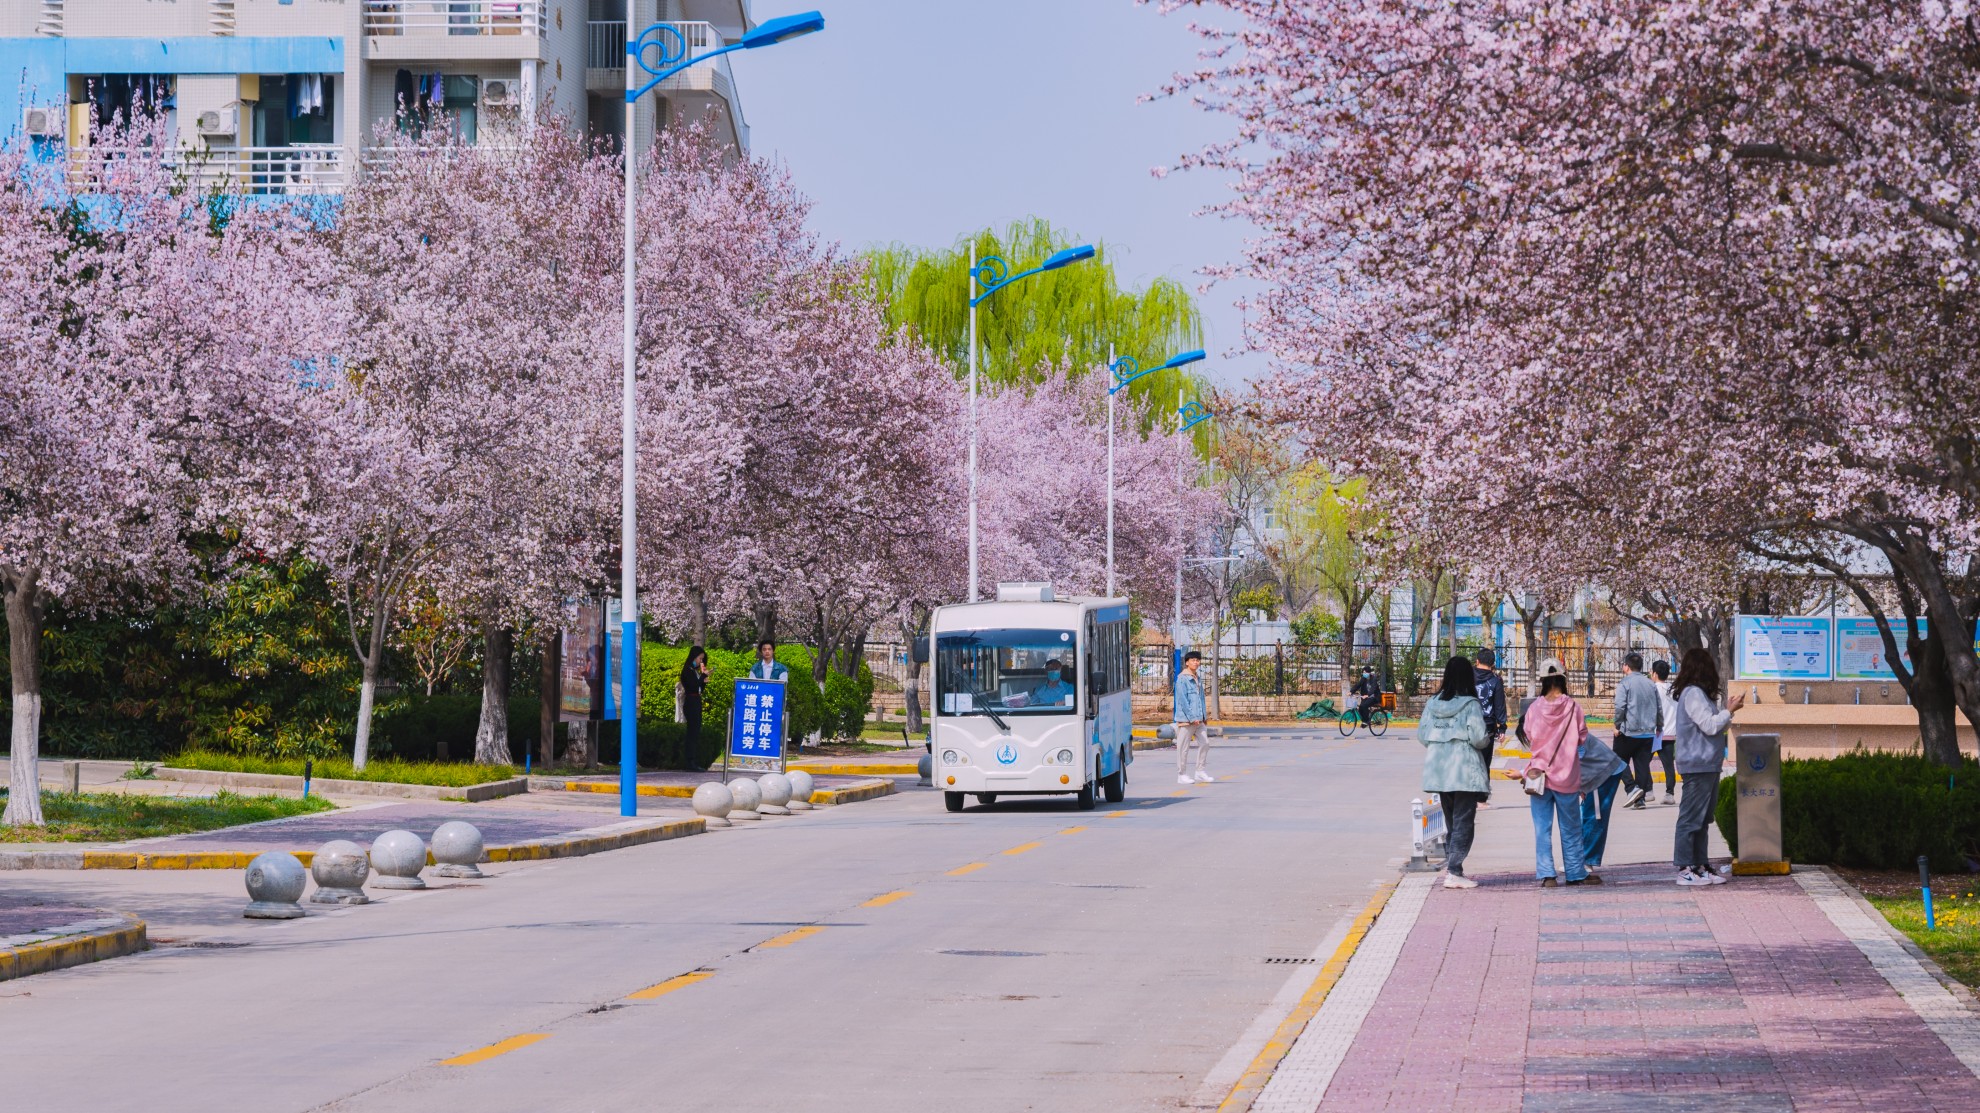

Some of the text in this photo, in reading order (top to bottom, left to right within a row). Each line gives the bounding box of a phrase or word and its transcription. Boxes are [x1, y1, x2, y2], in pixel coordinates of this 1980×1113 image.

[742, 693, 758, 750] 道路两旁
[758, 694, 774, 751] 禁止停车
